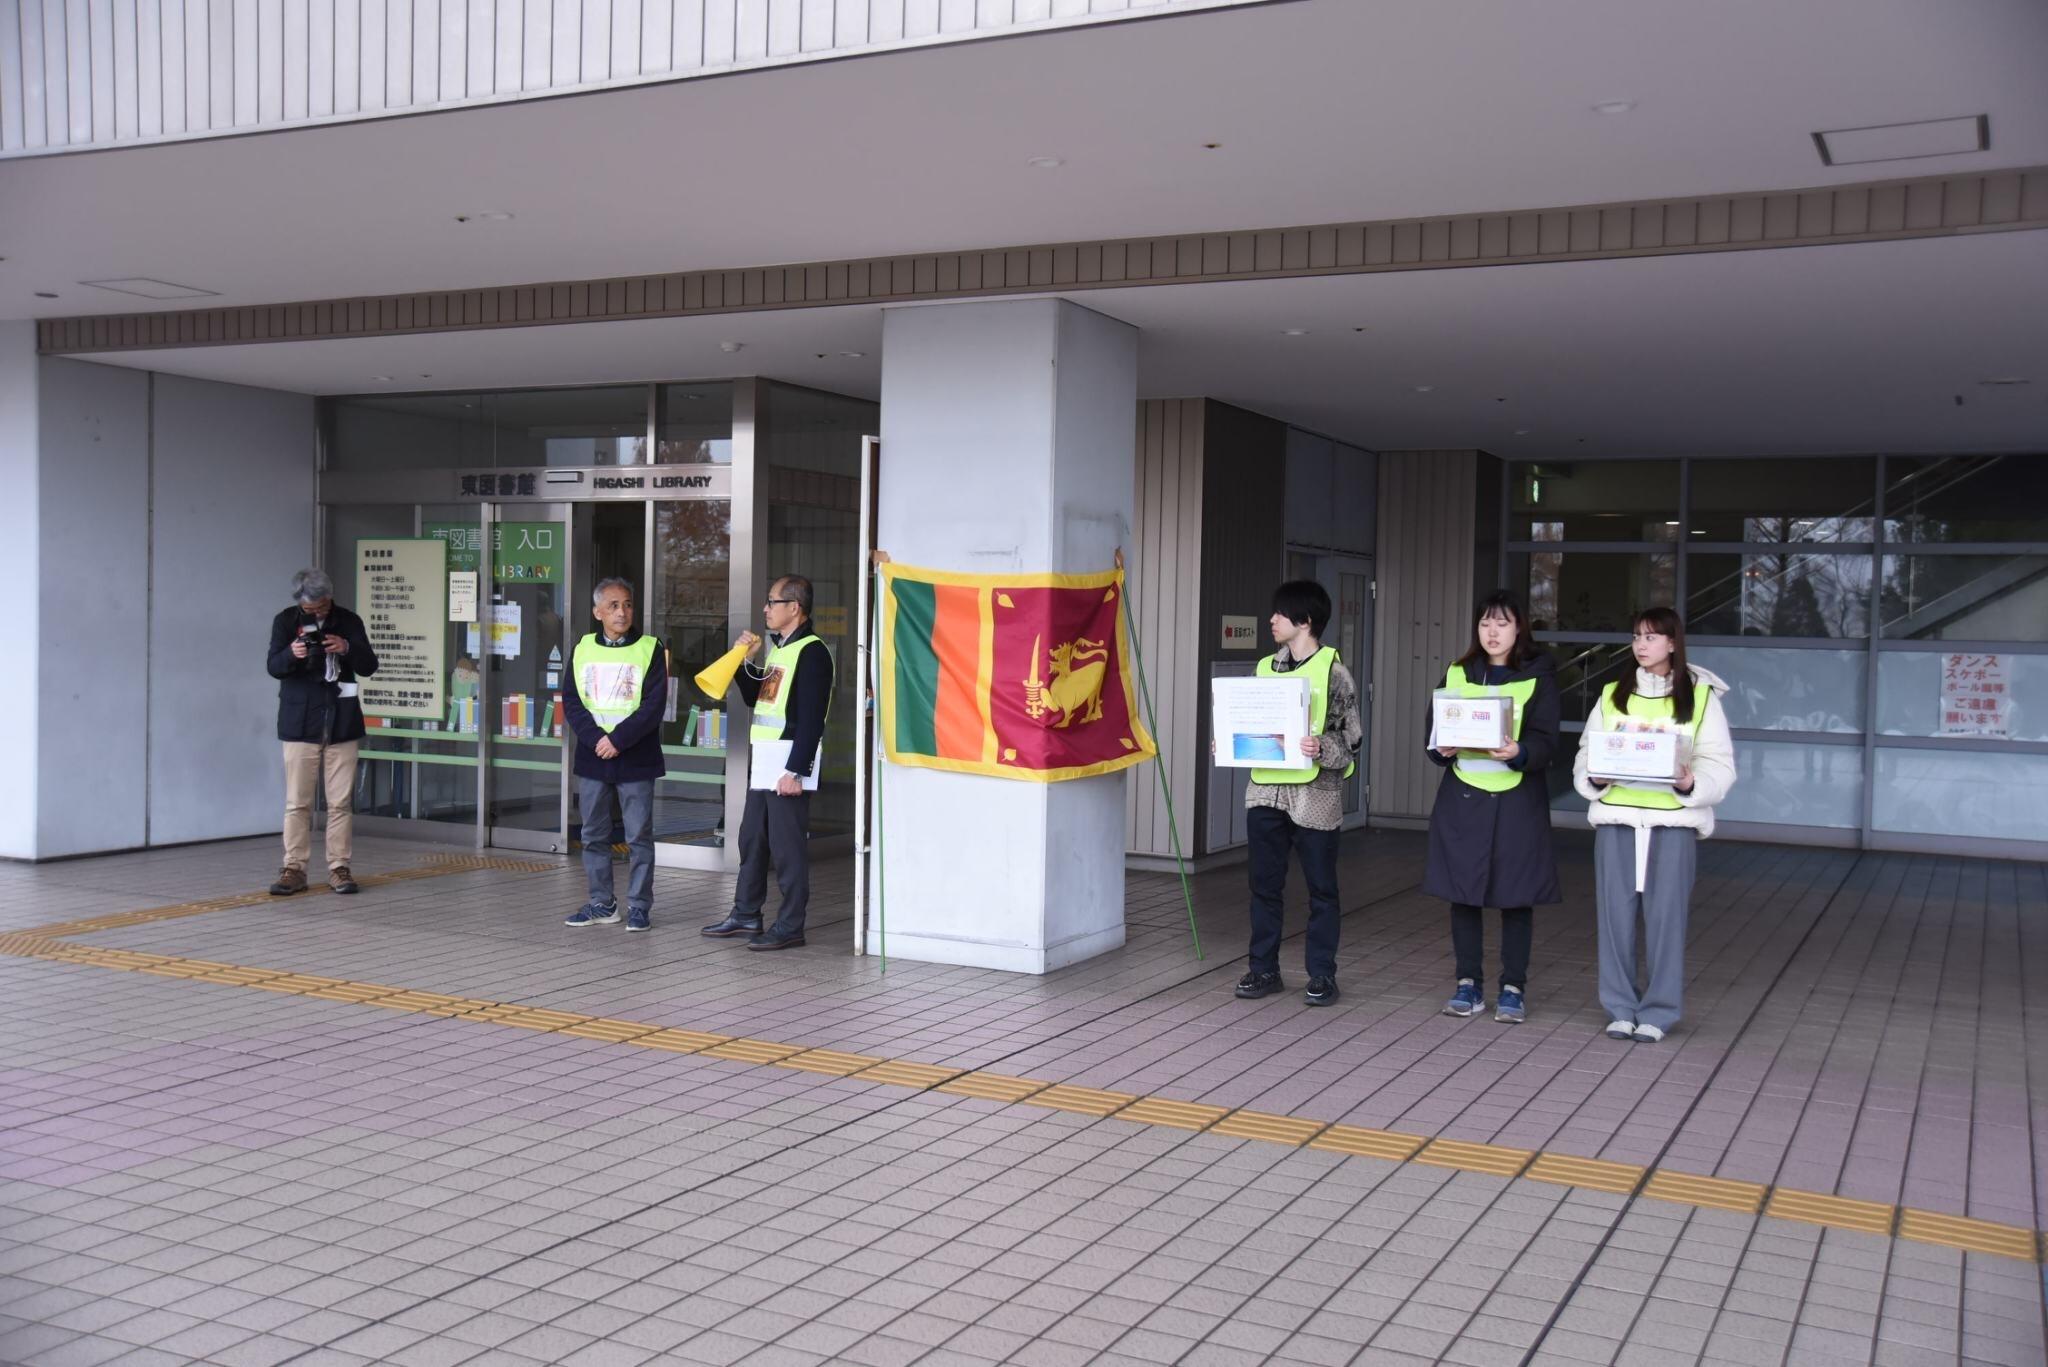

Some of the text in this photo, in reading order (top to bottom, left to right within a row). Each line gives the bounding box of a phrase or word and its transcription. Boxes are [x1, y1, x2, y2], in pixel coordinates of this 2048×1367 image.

[461, 473, 536, 496] 東図書館
[593, 476, 713, 489] HIGASHI LIBRARY
[517, 529, 552, 551] 入口
[494, 565, 551, 579] LIBRARY
[1950, 654, 1998, 668] ダンス
[1945, 668, 2001, 680] スケボー
